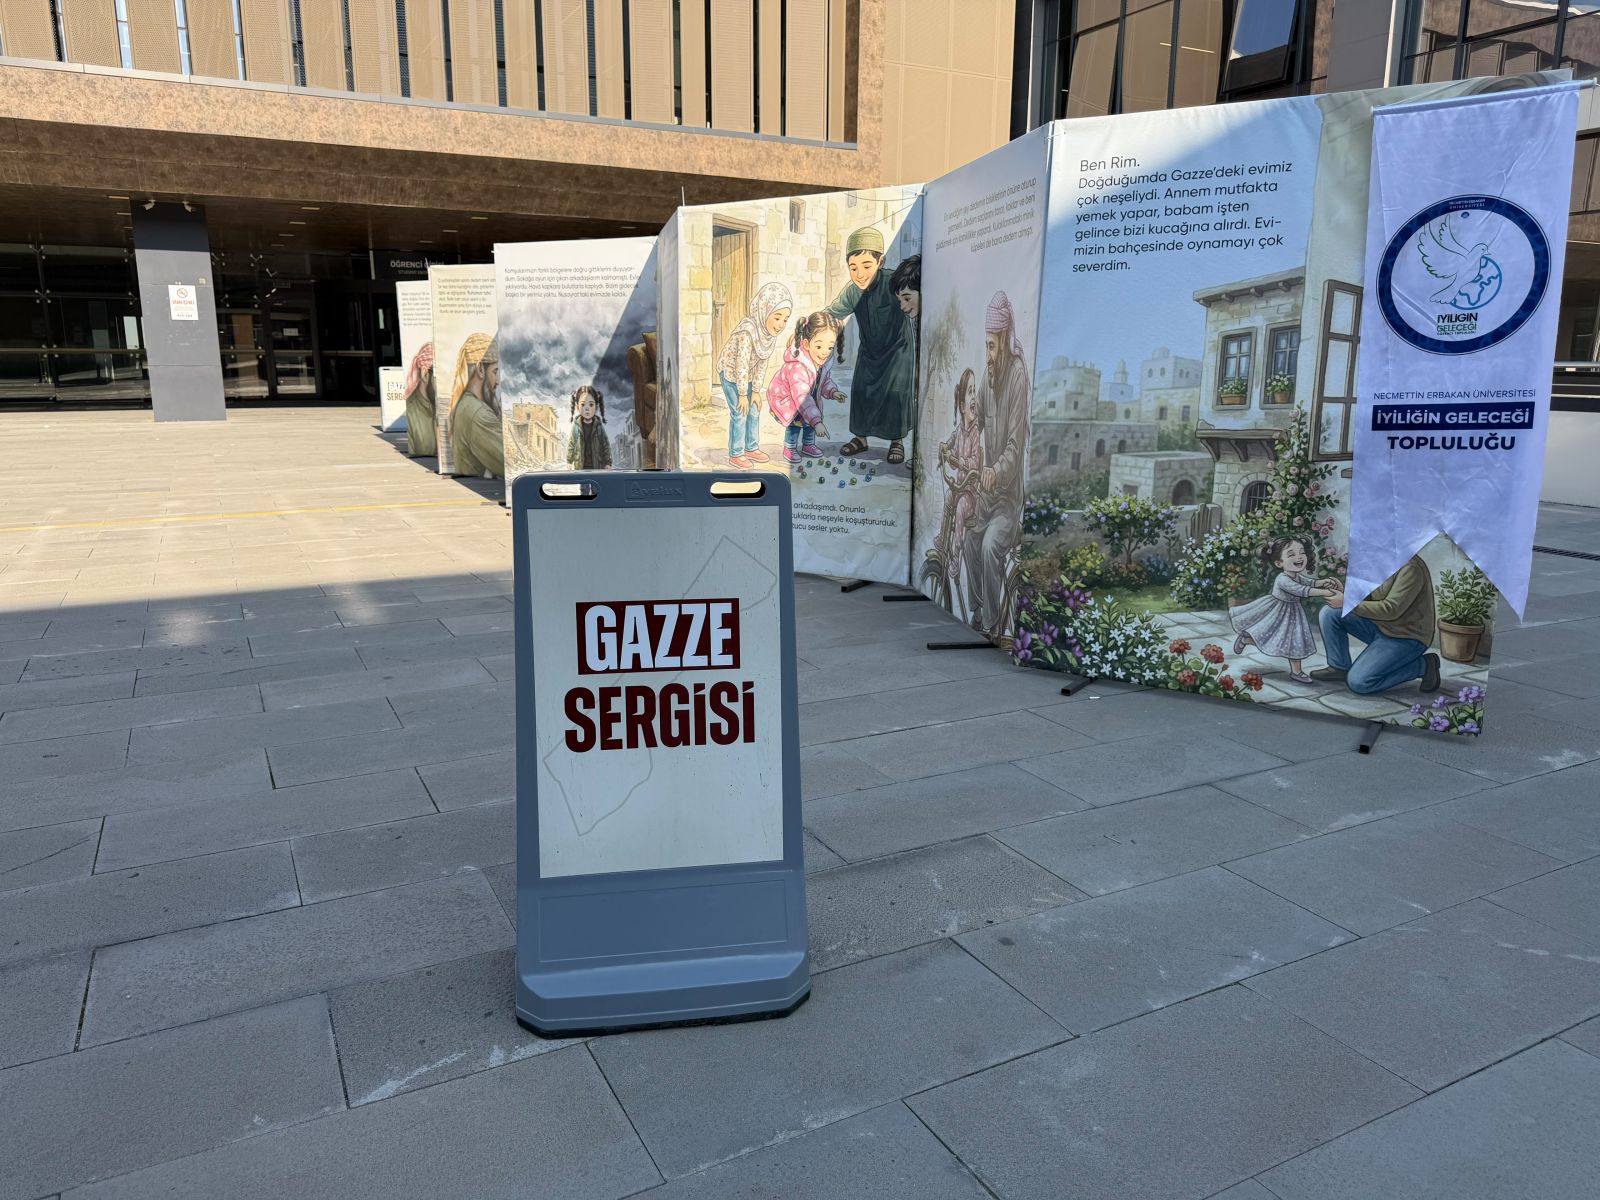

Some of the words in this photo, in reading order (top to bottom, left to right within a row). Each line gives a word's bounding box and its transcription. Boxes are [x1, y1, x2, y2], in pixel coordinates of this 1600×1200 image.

[1080, 160, 1106, 172] Ben
[1111, 156, 1140, 169] Rim.
[1079, 172, 1167, 189] Doğduğumda
[1171, 165, 1244, 180] Gazze'deki
[1249, 161, 1292, 175] evimiz
[1077, 194, 1099, 208] çok
[1103, 190, 1160, 206] neşeliydi.
[1164, 186, 1210, 199] Annem
[1215, 181, 1278, 195] mutfakta
[1076, 208, 1116, 224] yemek
[1120, 208, 1160, 222] yapar,
[1164, 203, 1213, 216] babam
[1217, 202, 1249, 215] işten
[1075, 226, 1119, 241] gelince
[1124, 224, 1144, 236] bizi
[1148, 220, 1209, 235] kucağına
[1214, 218, 1250, 230] alırdı.
[1074, 243, 1104, 256] mizin
[1108, 240, 1183, 255] bahçesinde
[1187, 238, 1254, 251] oynamayı
[1258, 234, 1283, 249] çok
[1072, 260, 1130, 272] severdim.
[1374, 391, 1425, 400] NECMETTİN
[1472, 389, 1536, 398] ÜNİVERSİTESİ
[1377, 410, 1440, 424] İYİLİĞİN
[1445, 408, 1529, 424] GELECEĞİ
[1387, 433, 1516, 450] TOPLULUĞU
[794, 502, 837, 512] arkadaşımdı.
[840, 505, 865, 513] Onunla
[808, 524, 827, 532] sesler
[817, 515, 844, 523] neşeyle
[846, 516, 898, 527] koşuştururduk.
[584, 602, 733, 672] GAZZE
[564, 681, 755, 753] SERGİSİ
